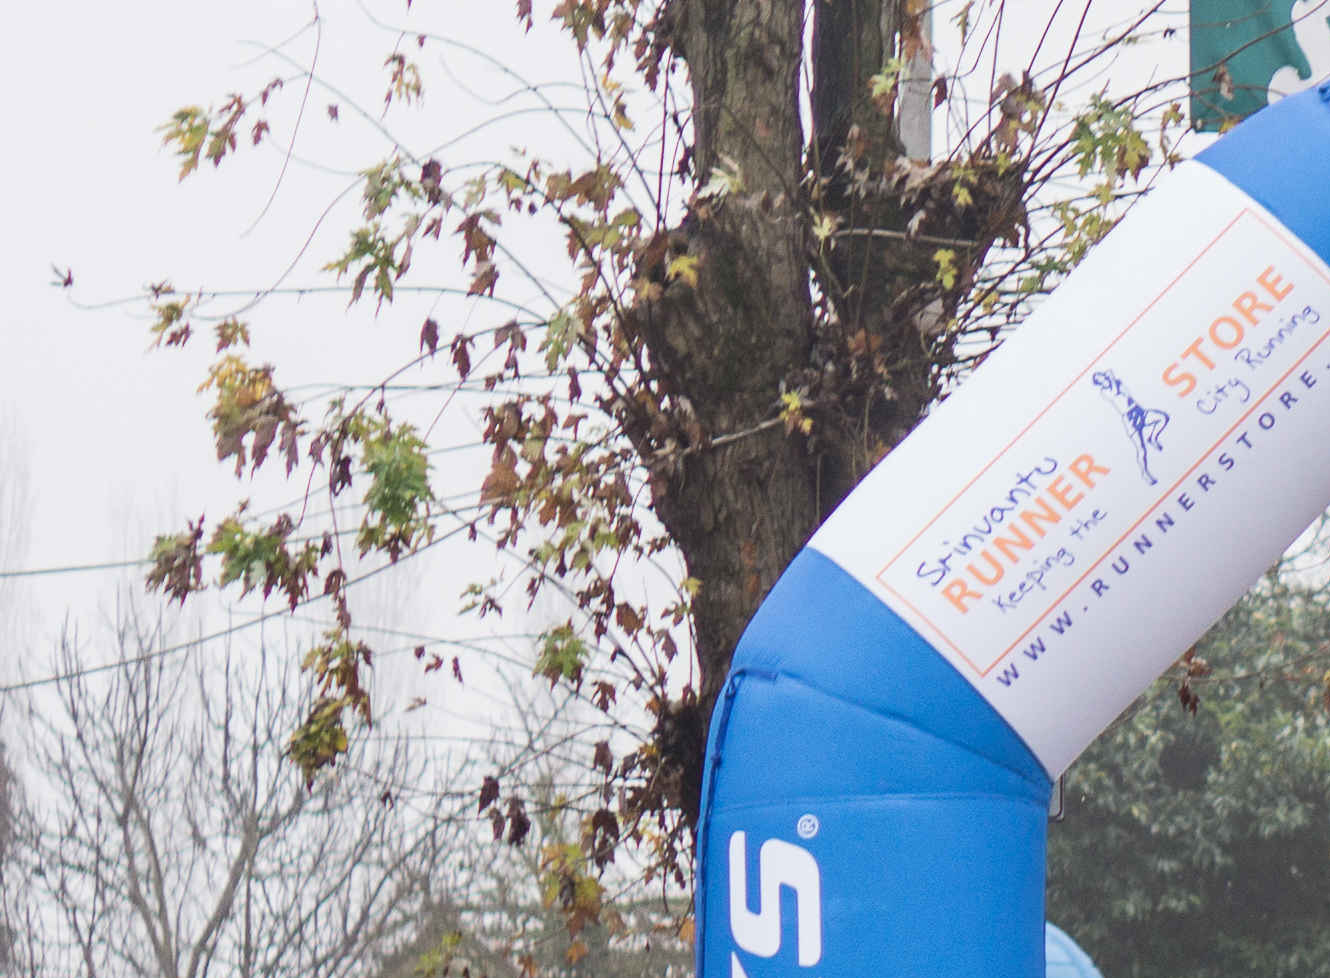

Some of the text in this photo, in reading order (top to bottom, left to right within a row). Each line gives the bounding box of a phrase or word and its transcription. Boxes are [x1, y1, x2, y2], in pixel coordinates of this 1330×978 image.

[1161, 264, 1295, 399] STORE
[1195, 303, 1320, 417] City Running
[941, 452, 1111, 615] RUNNER
[992, 505, 1108, 615] Keeping the
